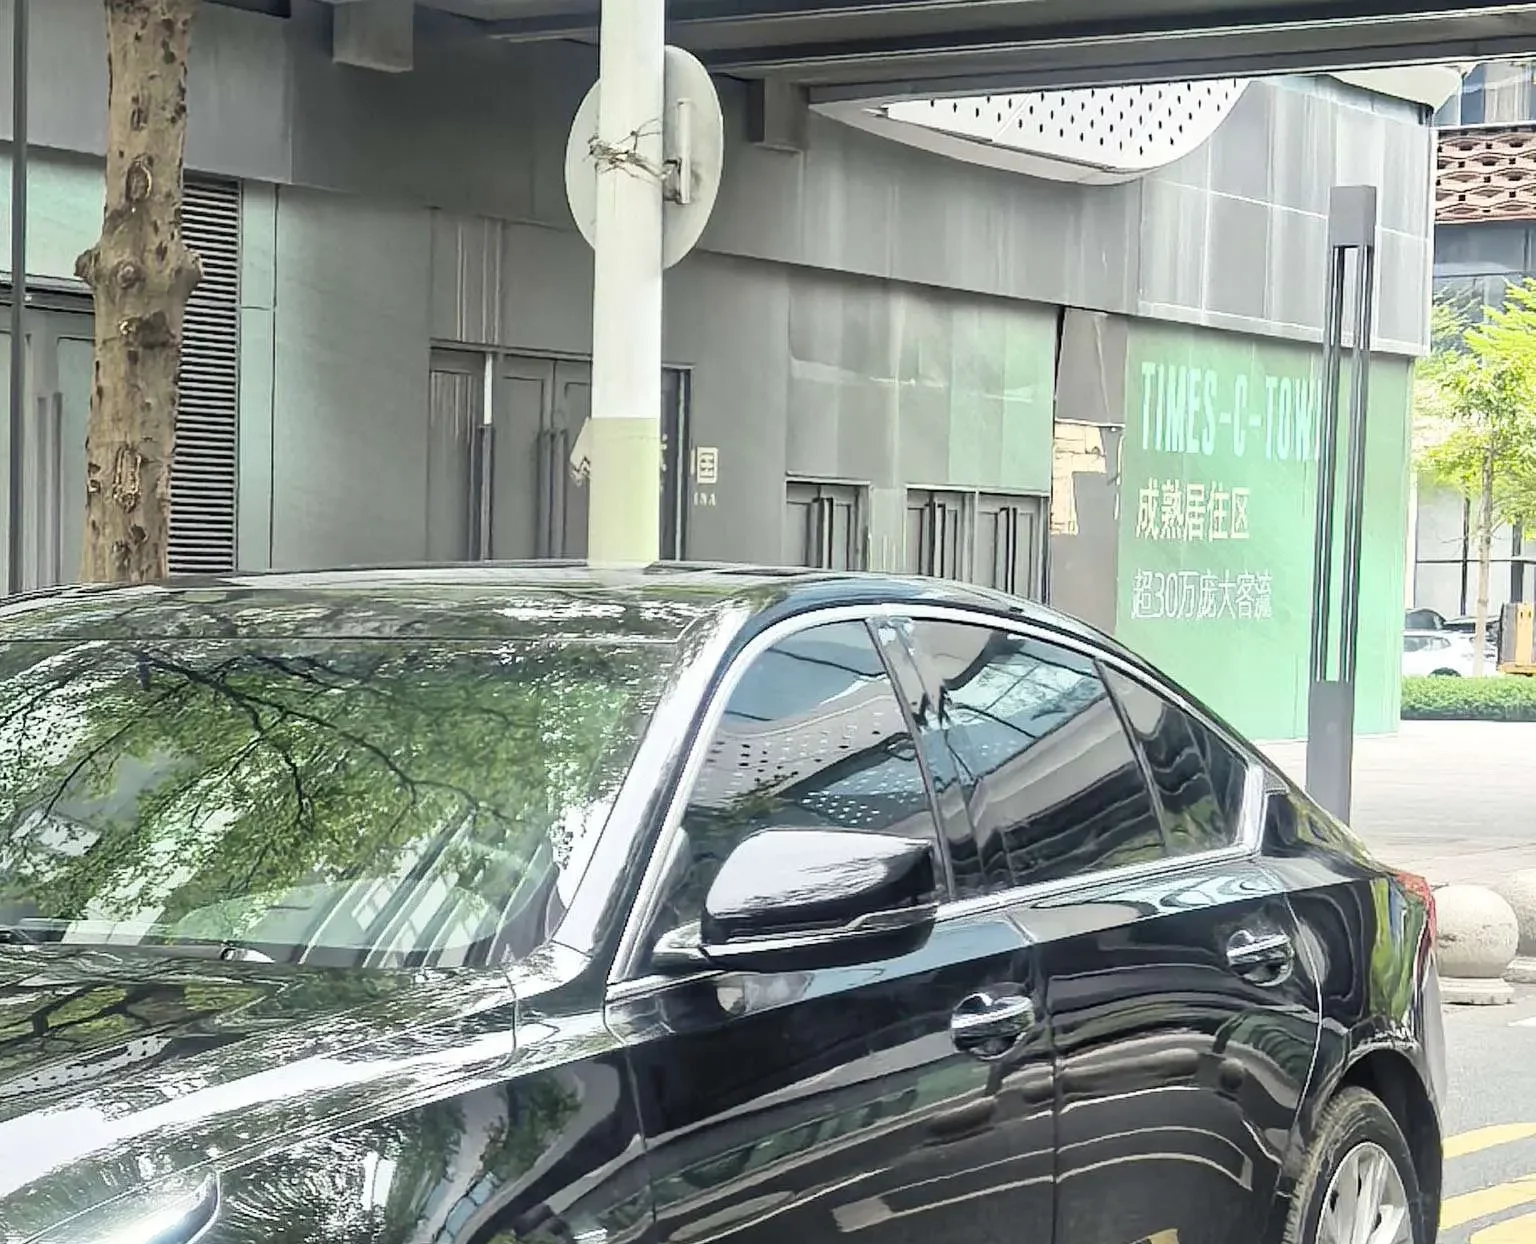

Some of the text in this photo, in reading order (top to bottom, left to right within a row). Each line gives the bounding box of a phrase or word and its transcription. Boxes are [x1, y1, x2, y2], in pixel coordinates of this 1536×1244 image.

[1135, 476, 1251, 543] 成熟居住区
[1130, 568, 1273, 621] 超30万庞大客流
